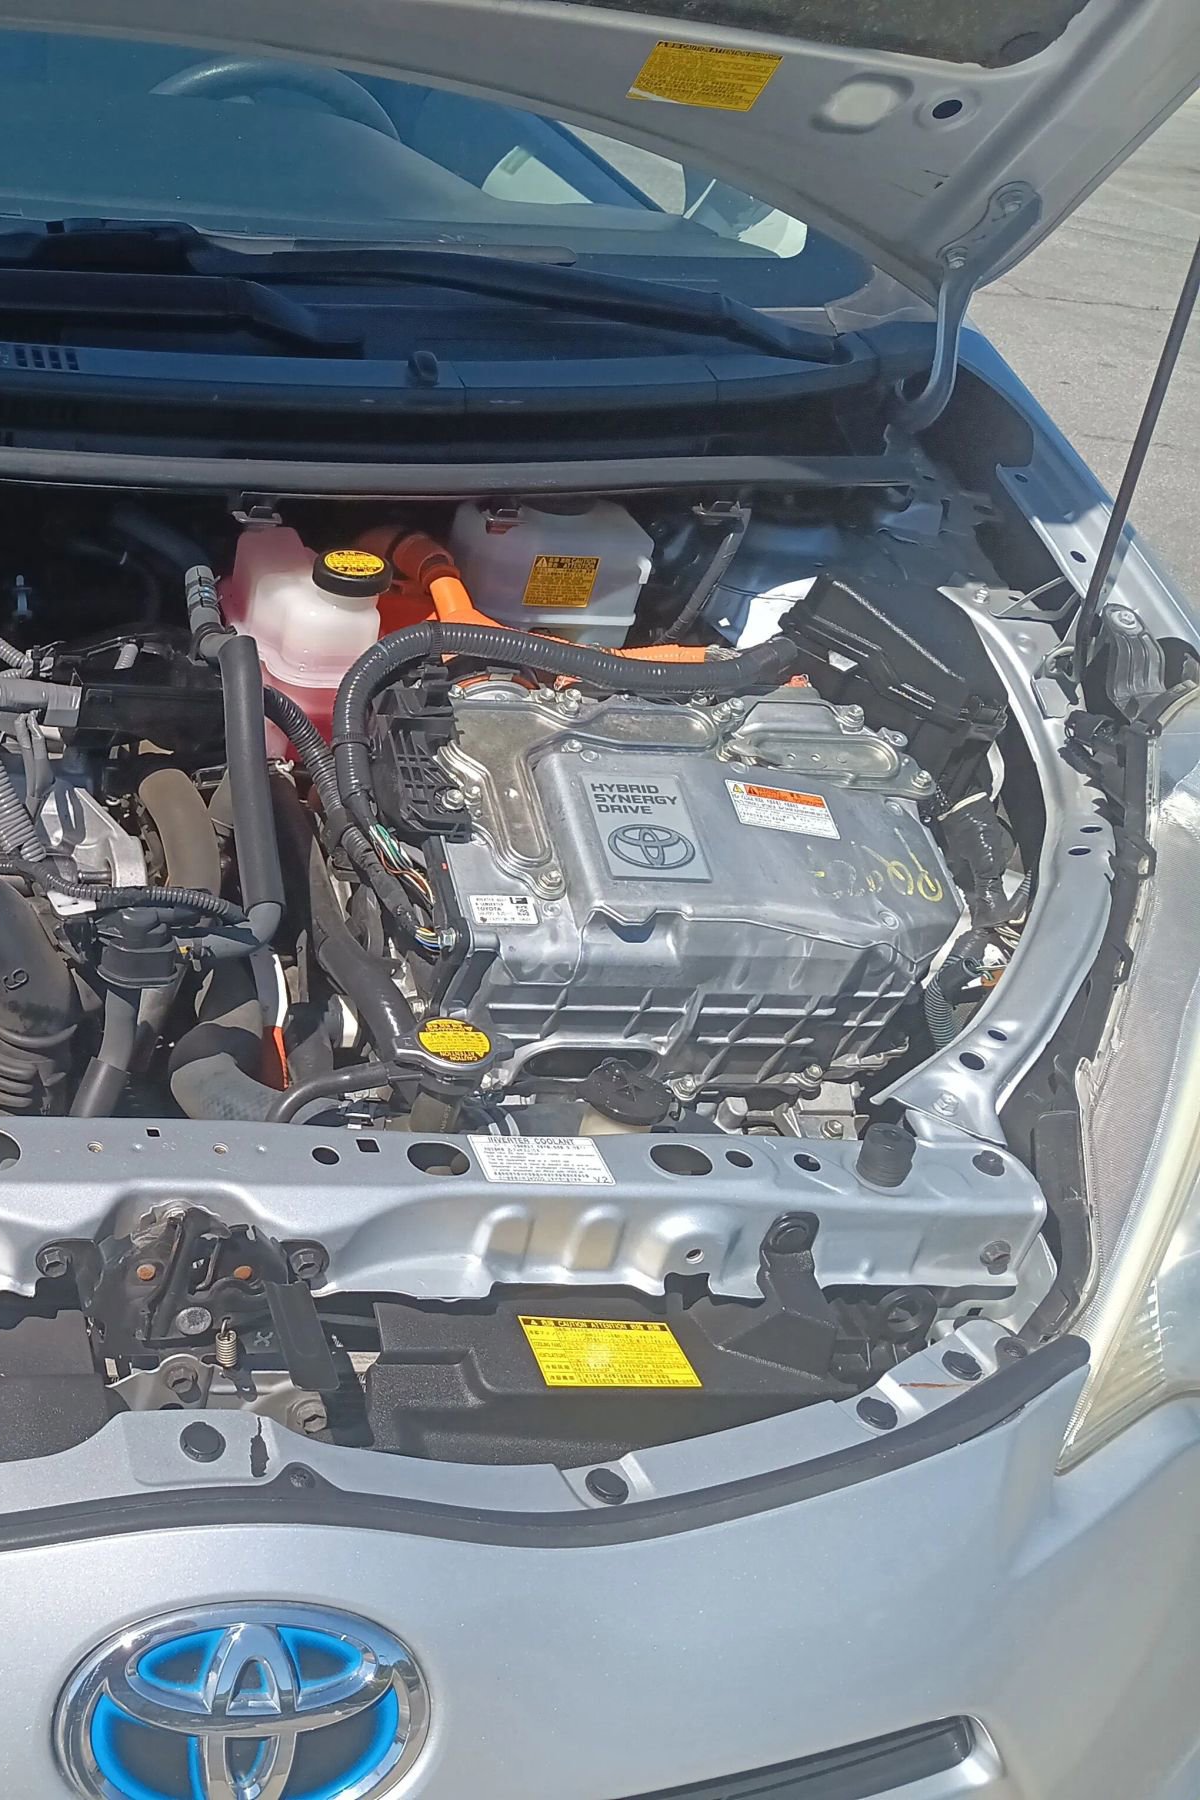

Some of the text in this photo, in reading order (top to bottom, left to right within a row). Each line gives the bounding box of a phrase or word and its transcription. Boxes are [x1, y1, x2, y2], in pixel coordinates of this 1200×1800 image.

[590, 783, 659, 794] HYBRID
[593, 793, 678, 805] SYNERGY
[597, 804, 653, 814] DRIVE
[557, 1320, 588, 1328] CAUTION
[590, 1322, 628, 1330] ATTENTION
